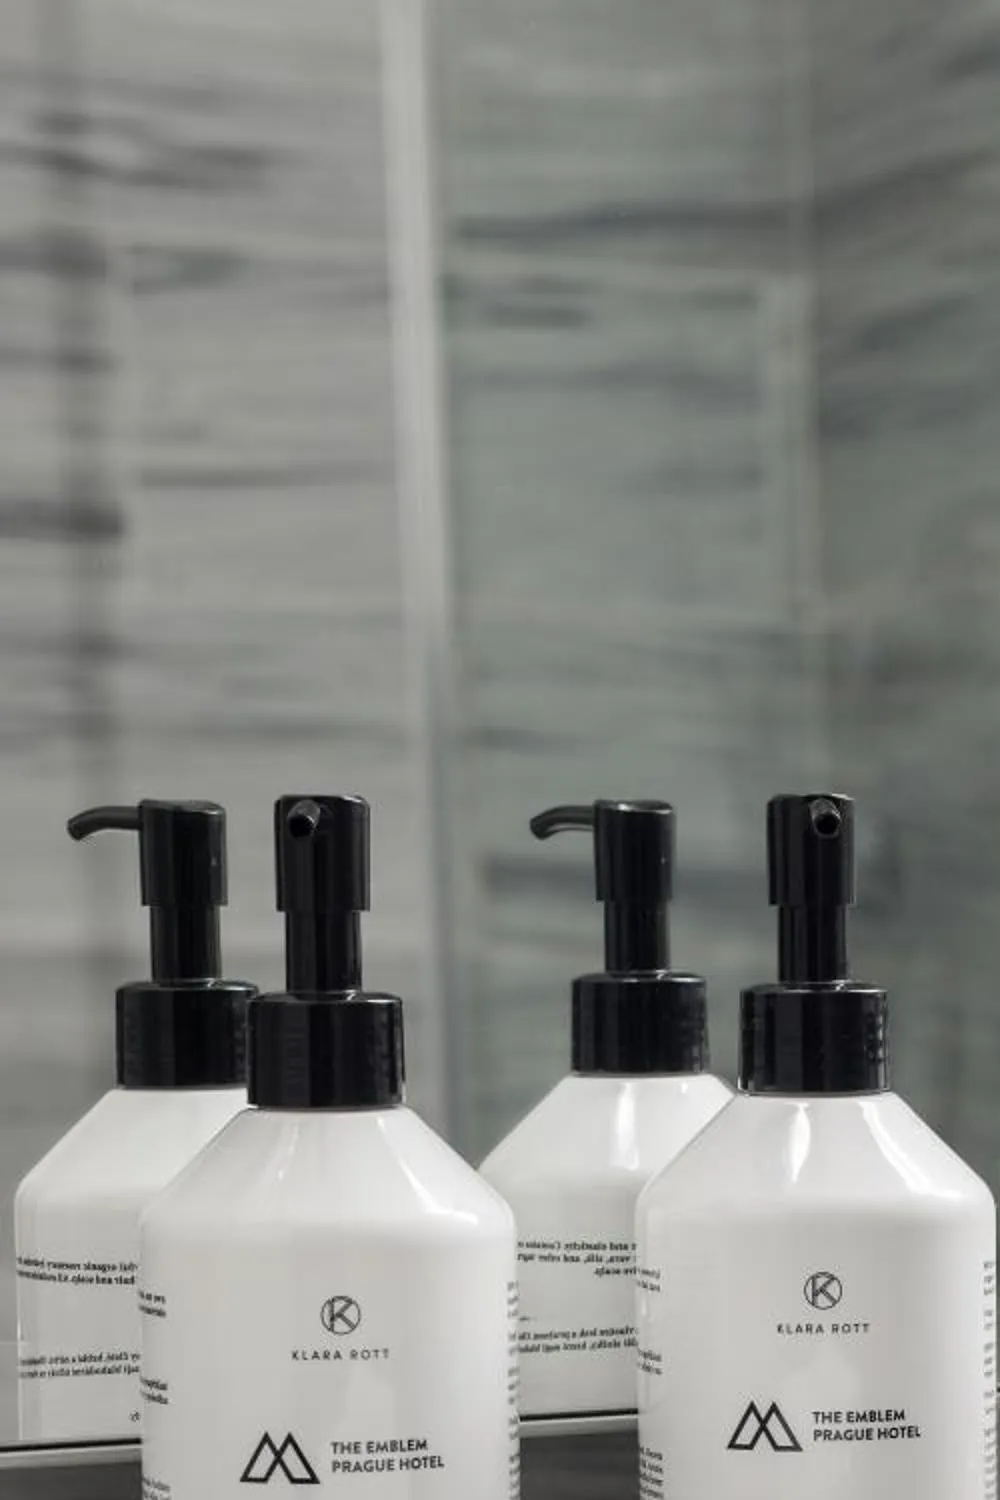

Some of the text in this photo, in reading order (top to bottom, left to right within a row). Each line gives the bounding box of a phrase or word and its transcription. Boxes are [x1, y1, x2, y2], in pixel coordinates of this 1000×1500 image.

[777, 1323, 870, 1334] KLARA ROTT
[292, 1348, 391, 1361] KLARA ROTT
[812, 1410, 905, 1424] THE EMBLEM
[812, 1426, 920, 1442] PRAGUE HOTEL
[331, 1439, 428, 1454] THE EMBLEM
[332, 1456, 444, 1472] PRAGUE HOTEL
